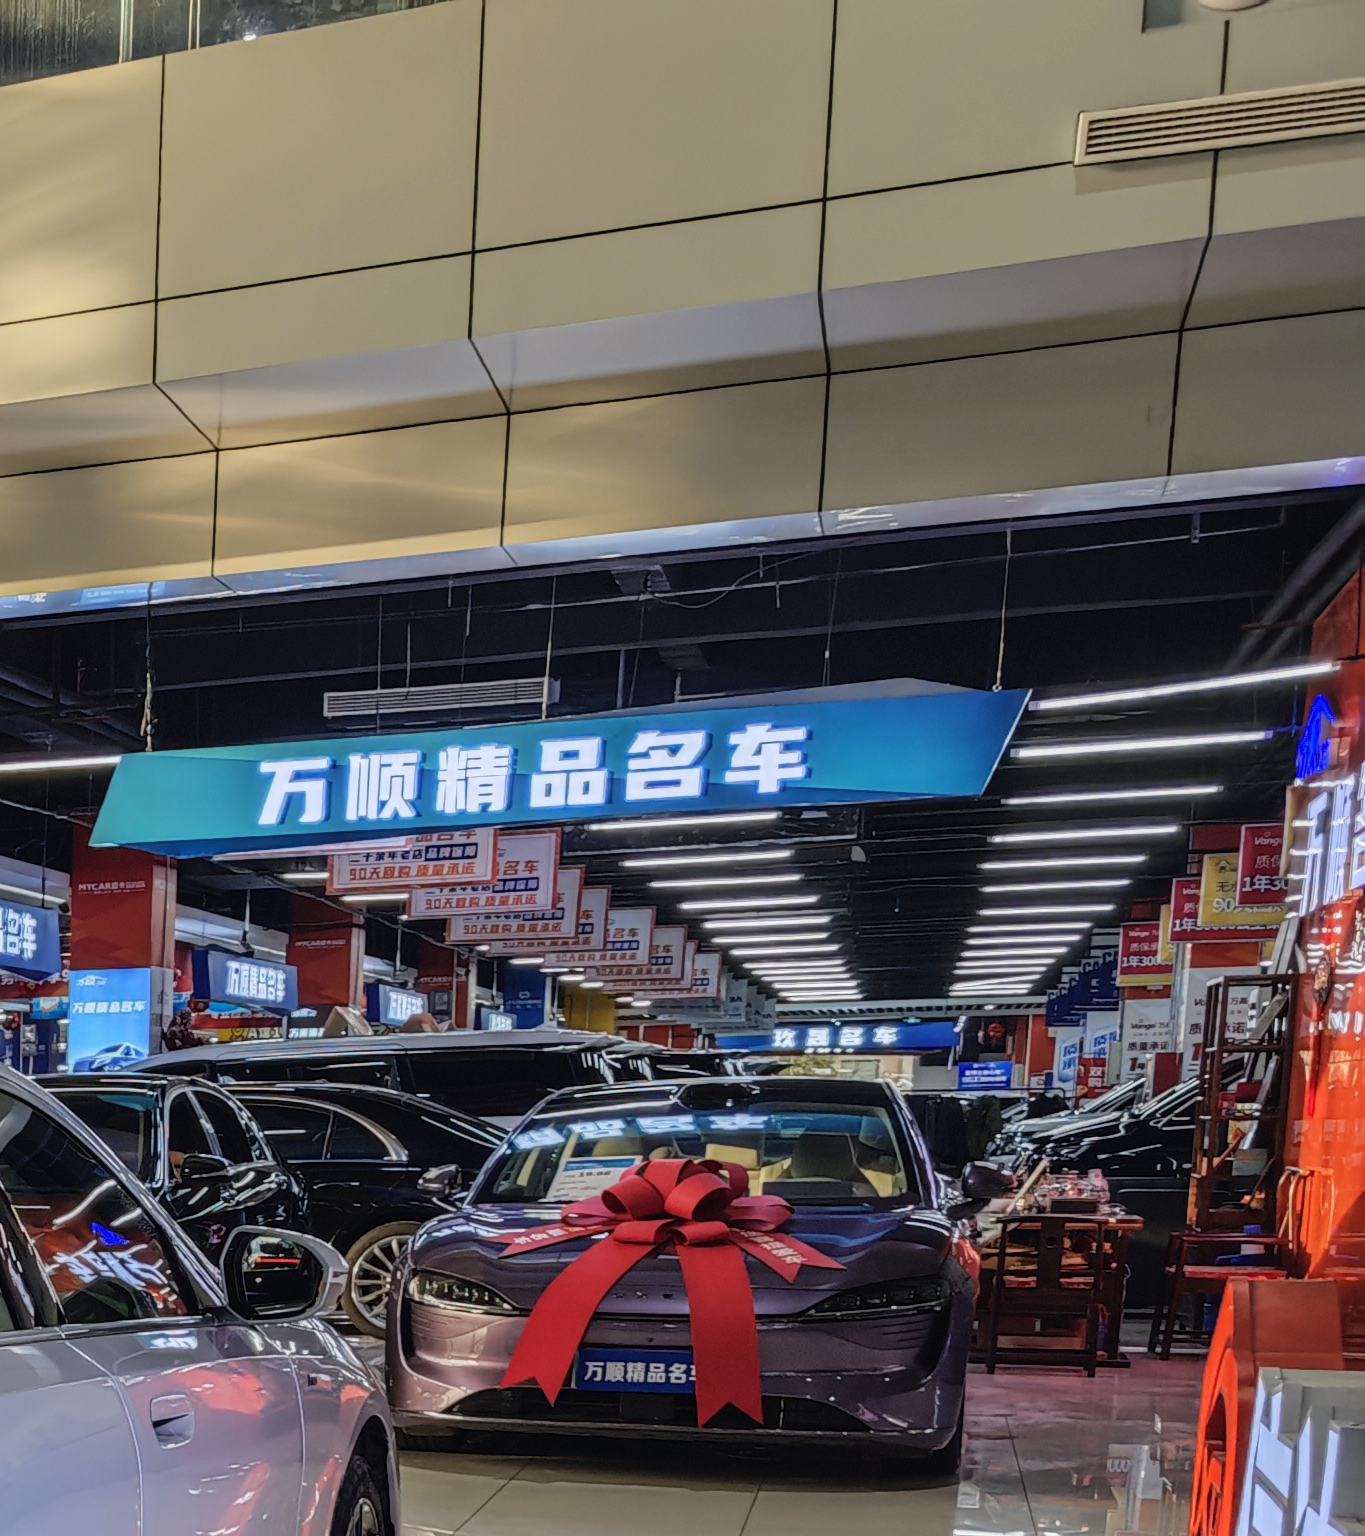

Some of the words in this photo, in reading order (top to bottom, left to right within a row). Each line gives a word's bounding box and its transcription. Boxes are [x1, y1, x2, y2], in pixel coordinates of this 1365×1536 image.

[257, 722, 809, 826] 万顺精品名车
